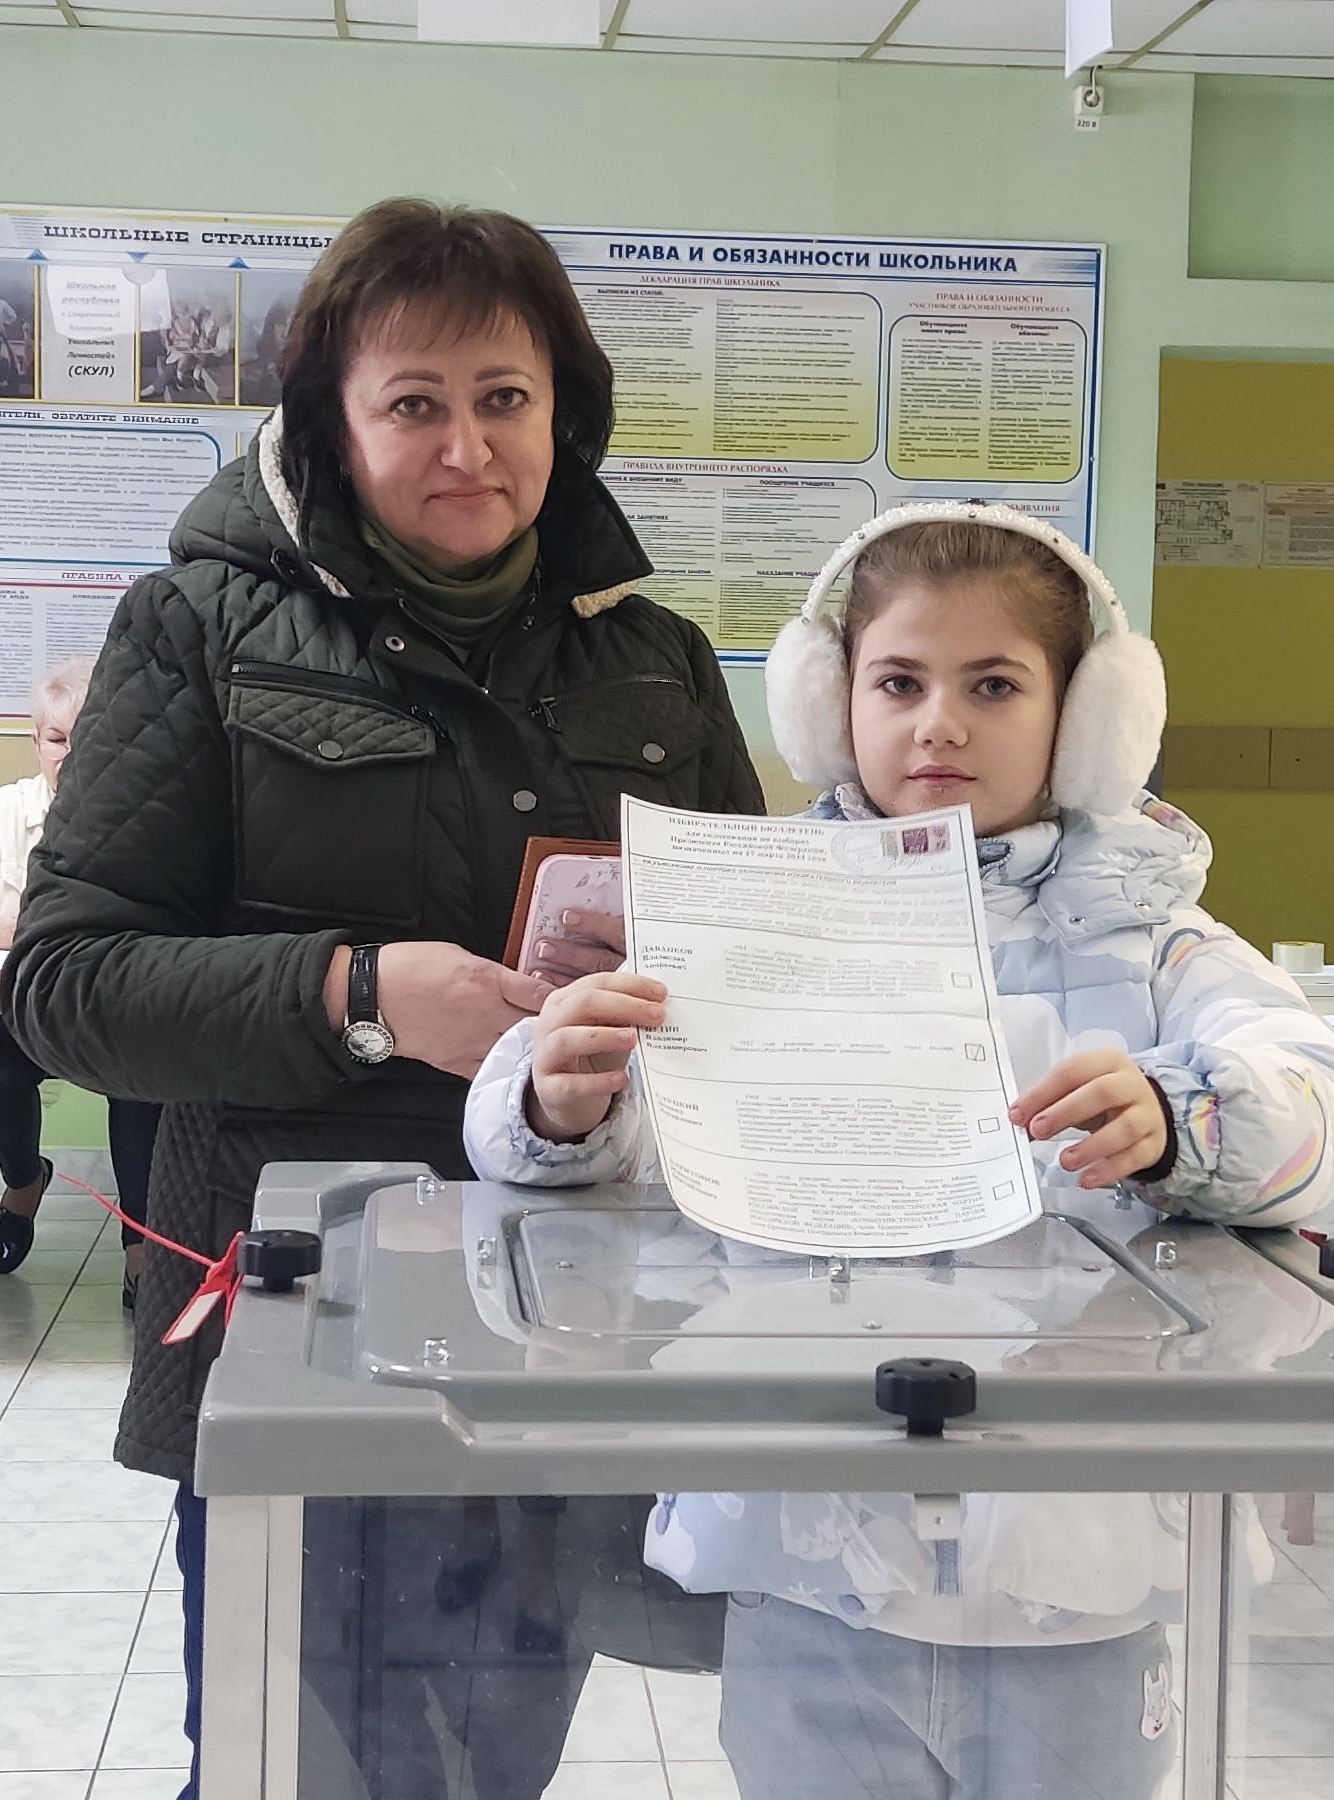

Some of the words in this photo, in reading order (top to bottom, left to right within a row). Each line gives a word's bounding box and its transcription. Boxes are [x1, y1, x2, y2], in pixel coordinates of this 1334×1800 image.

[44, 225, 189, 243] ШКОЛЬНЫЕ
[609, 243, 680, 262] ПРАВА
[689, 246, 704, 262] И
[712, 247, 871, 268] ОБЯЗАННОСТИ
[879, 252, 1018, 272] ШКОЛЬНИКА
[68, 364, 115, 378] (СКУЛ)
